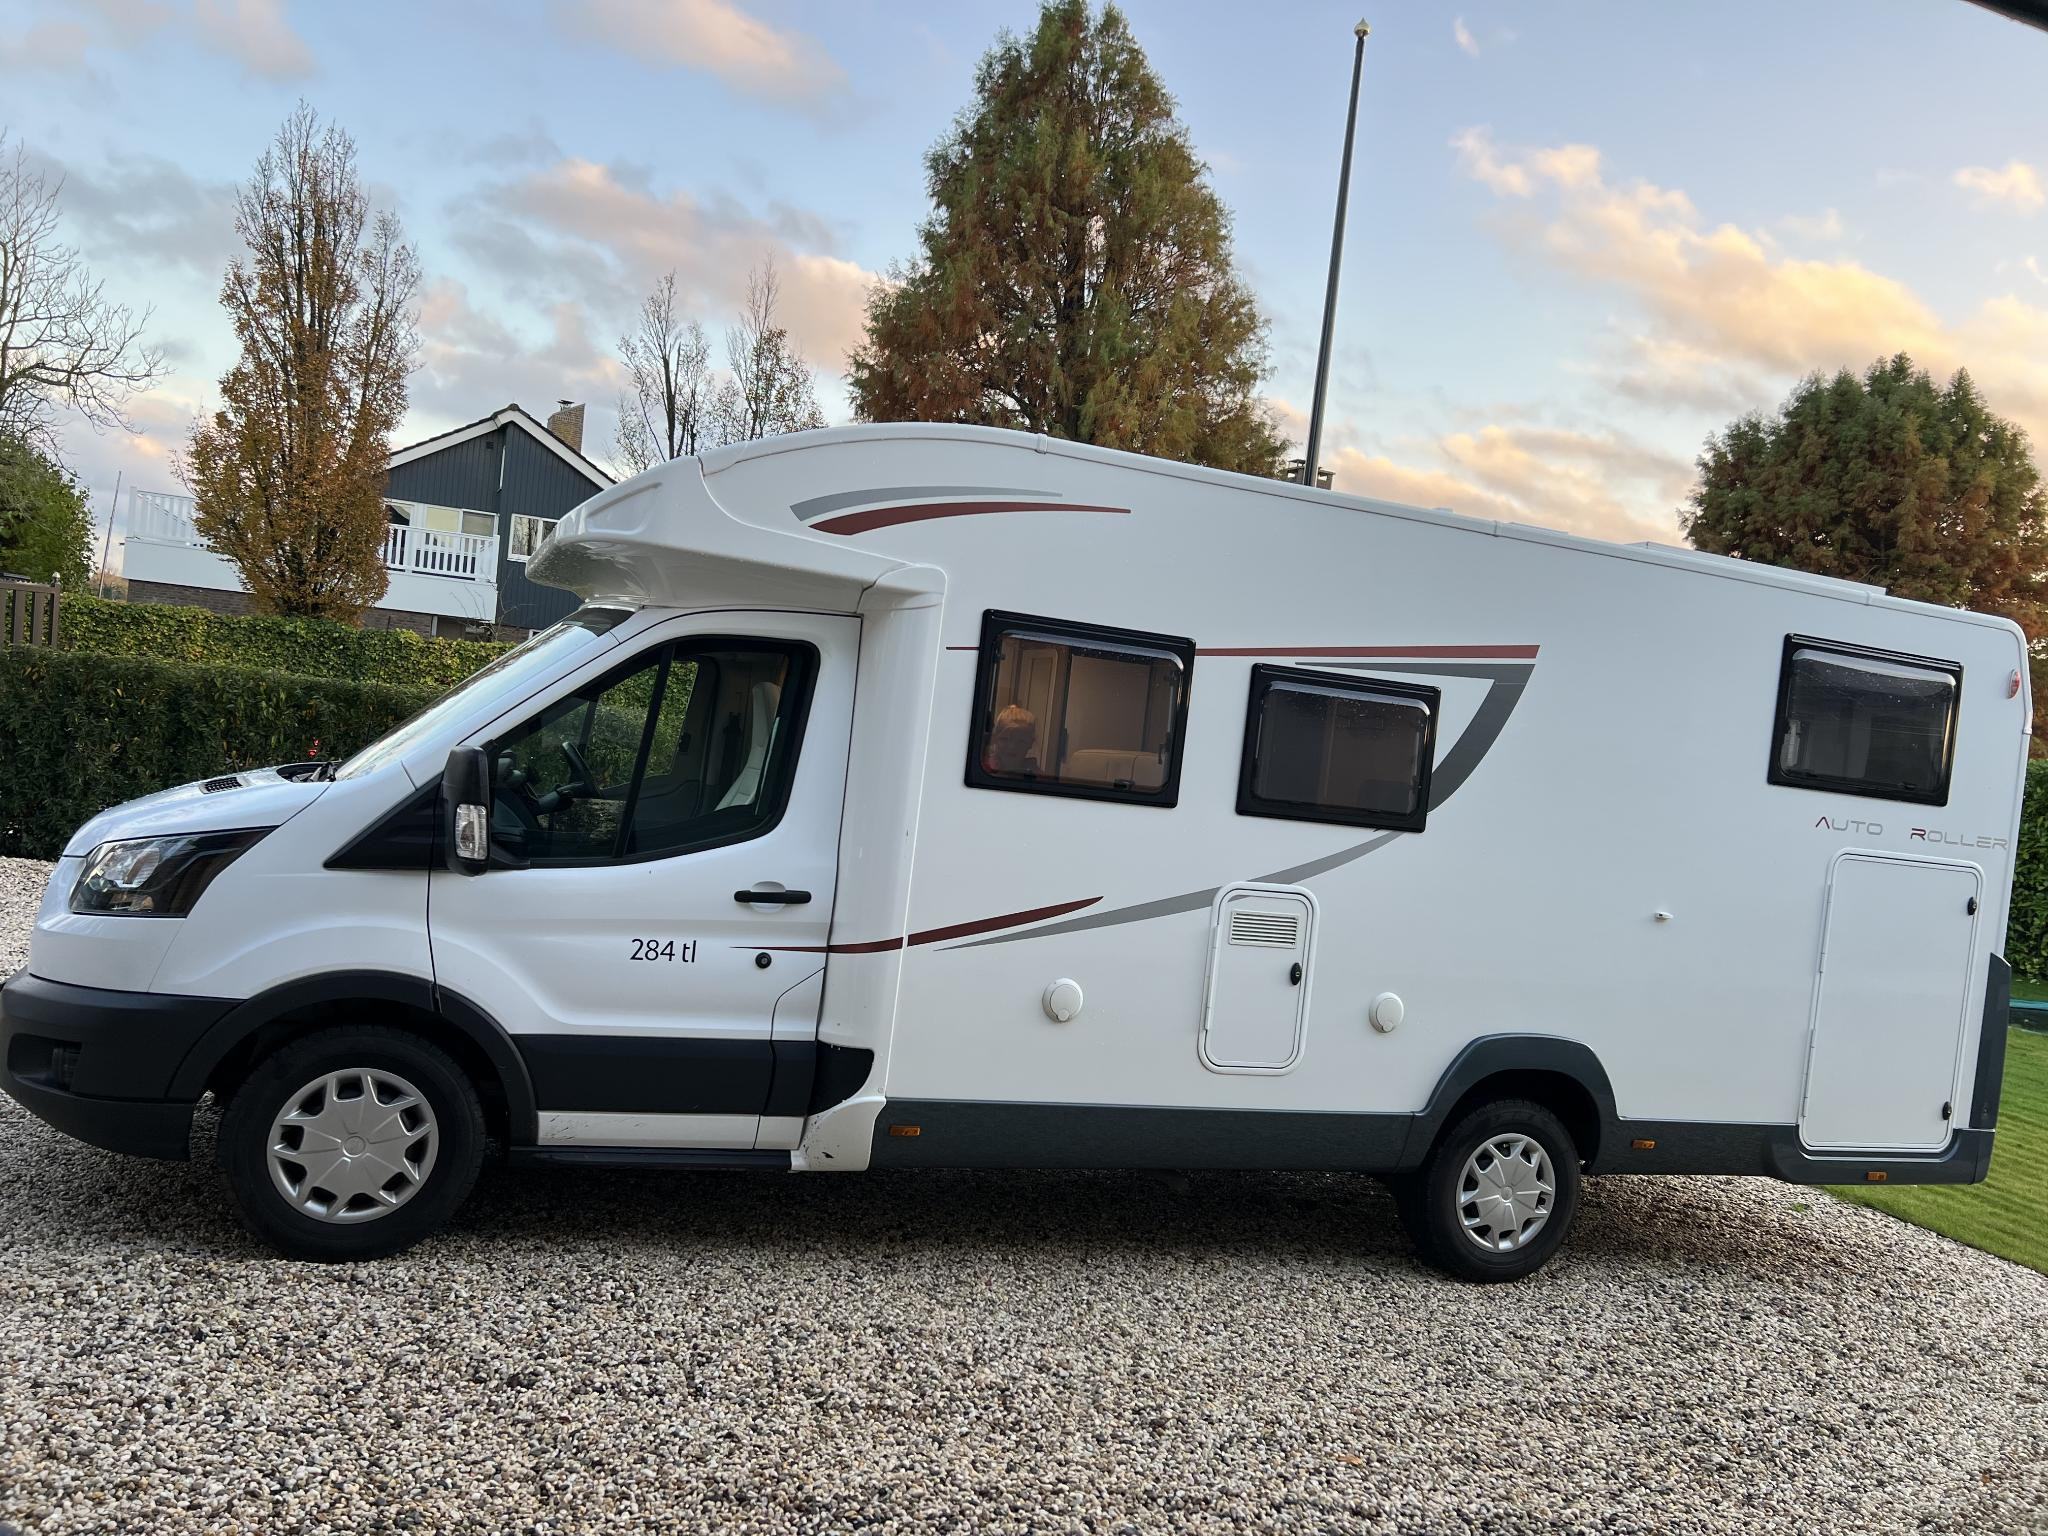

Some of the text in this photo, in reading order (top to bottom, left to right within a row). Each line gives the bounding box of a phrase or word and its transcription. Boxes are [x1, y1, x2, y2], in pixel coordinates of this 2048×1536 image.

[1815, 816, 2008, 850] AUTO ROLLER
[629, 938, 697, 963] 284 tl
